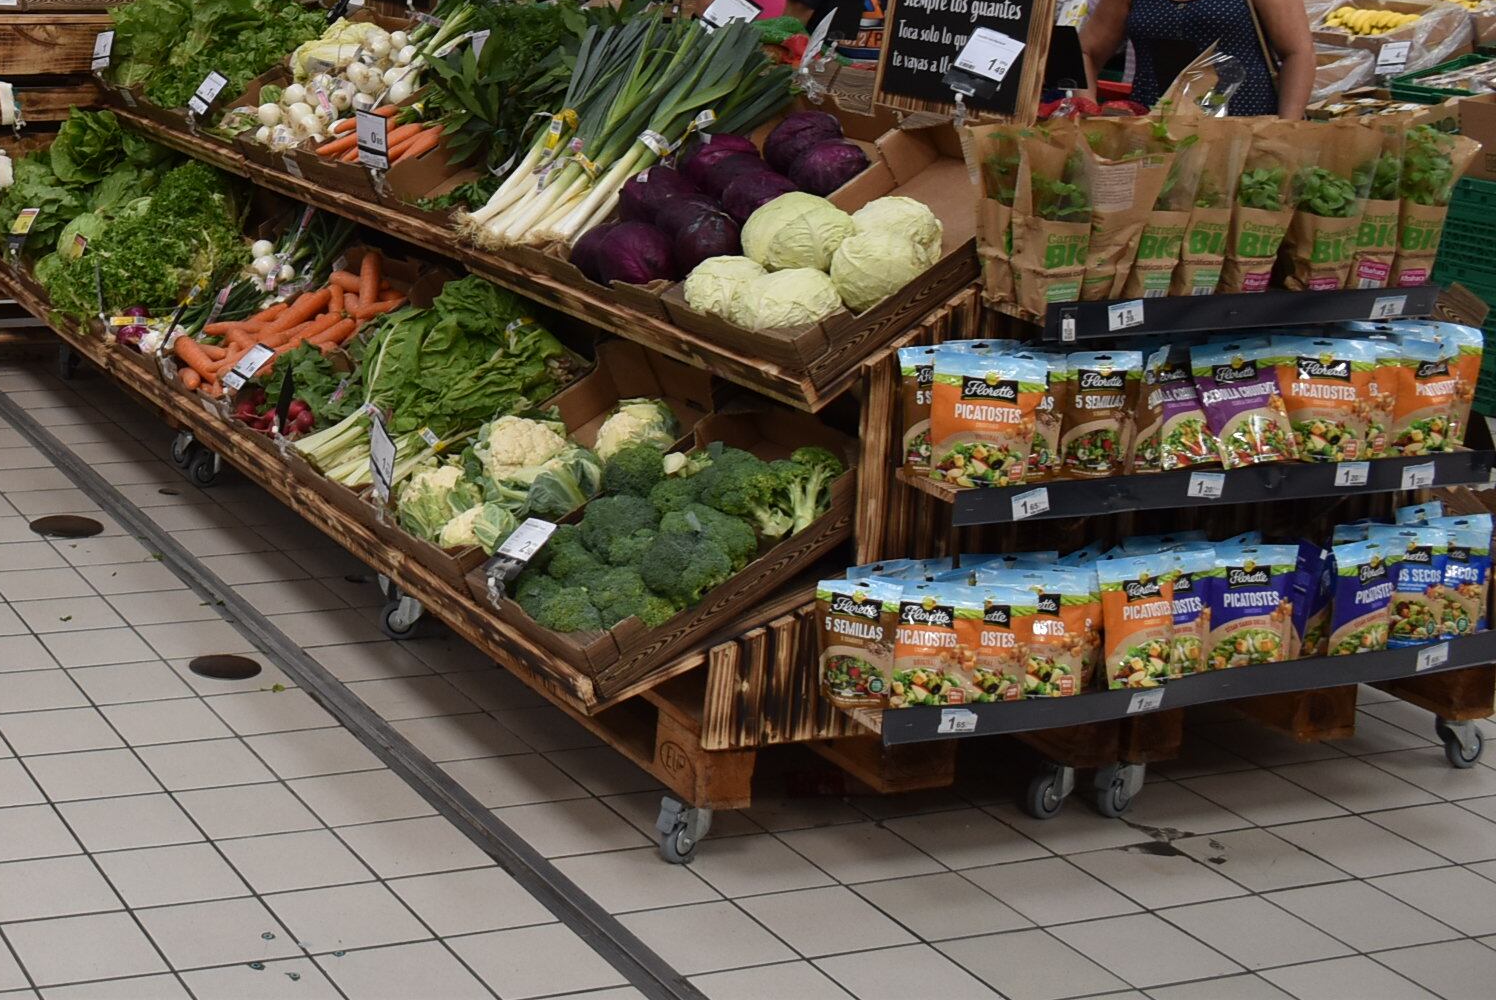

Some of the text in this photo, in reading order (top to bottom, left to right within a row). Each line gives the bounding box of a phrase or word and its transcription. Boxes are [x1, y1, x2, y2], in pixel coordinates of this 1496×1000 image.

[898, 19, 954, 45] Toca solo lo
[892, 48, 903, 66] te
[903, 53, 928, 75] vayas
[929, 58, 937, 72] a
[1215, 366, 1255, 381] Florette
[1301, 360, 1349, 378] Florette
[964, 379, 1015, 399] Florette
[1080, 371, 1124, 388] Florette
[1291, 381, 1356, 400] PICATOSTES
[1075, 394, 1128, 411] 5 SEMILLAS
[954, 402, 1023, 424] PICATOSTES
[1229, 569, 1269, 587] Florette
[1412, 567, 1443, 583] SECOS
[1444, 563, 1479, 582] SECOS
[1222, 590, 1280, 608] PICATOSTES
[1354, 581, 1394, 605] PICATOSTES
[832, 596, 879, 618] Florette
[901, 604, 950, 626] Florette
[824, 616, 883, 640] 5 SEMILLAS
[980, 630, 1016, 648] OSTES
